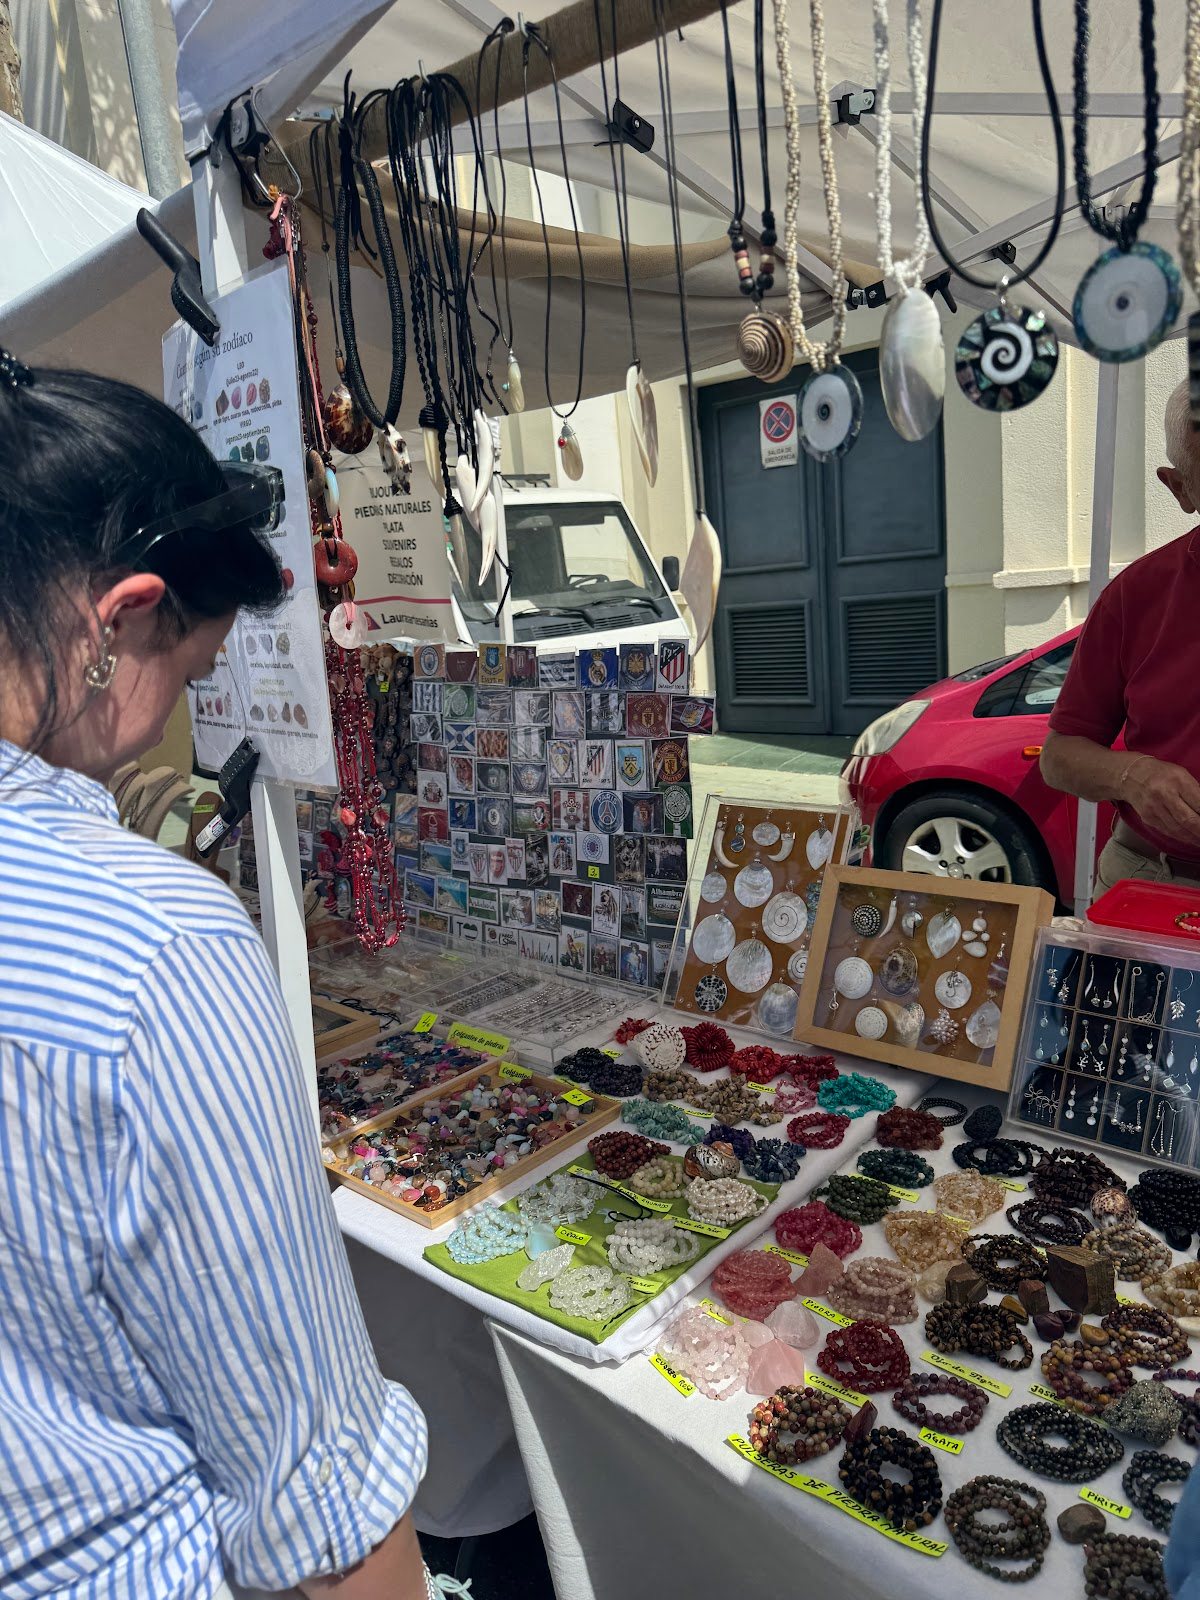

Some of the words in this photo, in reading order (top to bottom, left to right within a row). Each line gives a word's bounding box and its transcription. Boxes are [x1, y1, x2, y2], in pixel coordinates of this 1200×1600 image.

[354, 504, 384, 519] PIEDRAS
[385, 500, 432, 516] NATURALES
[382, 520, 405, 534] PLATA
[550, 834, 574, 845] MESI
[732, 1437, 798, 1480] PULSERAS
[803, 1478, 828, 1491] DE
[880, 1521, 949, 1554] NATURAL
